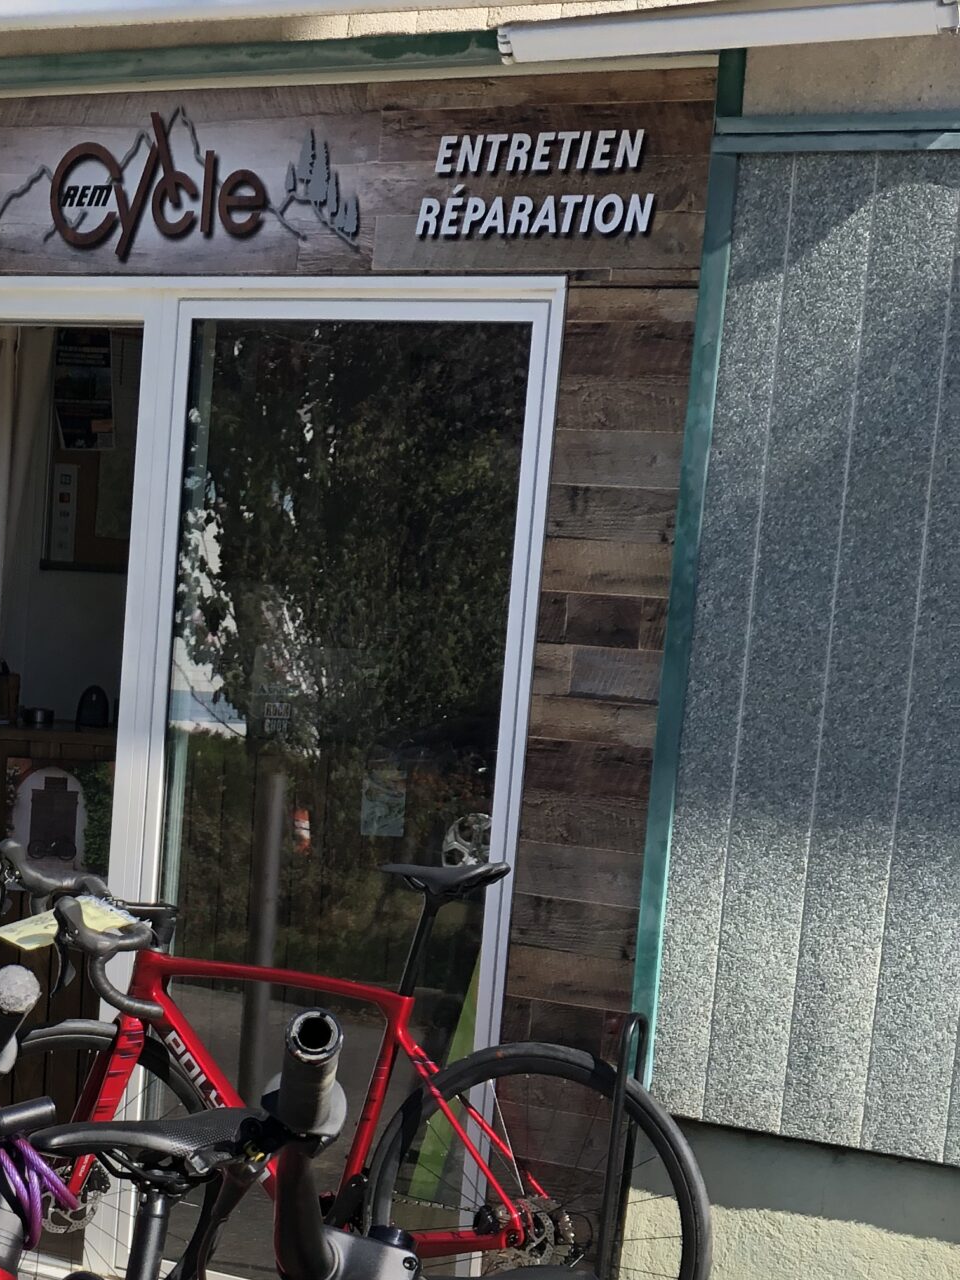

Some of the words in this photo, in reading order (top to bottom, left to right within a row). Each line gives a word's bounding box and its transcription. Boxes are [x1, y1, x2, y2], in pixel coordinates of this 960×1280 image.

[435, 129, 645, 173] ENTRETIEN
[50, 112, 271, 256] Cycle
[61, 184, 114, 207] REM
[416, 184, 654, 235] RÉPARATION
[164, 1030, 227, 1108] POLY
